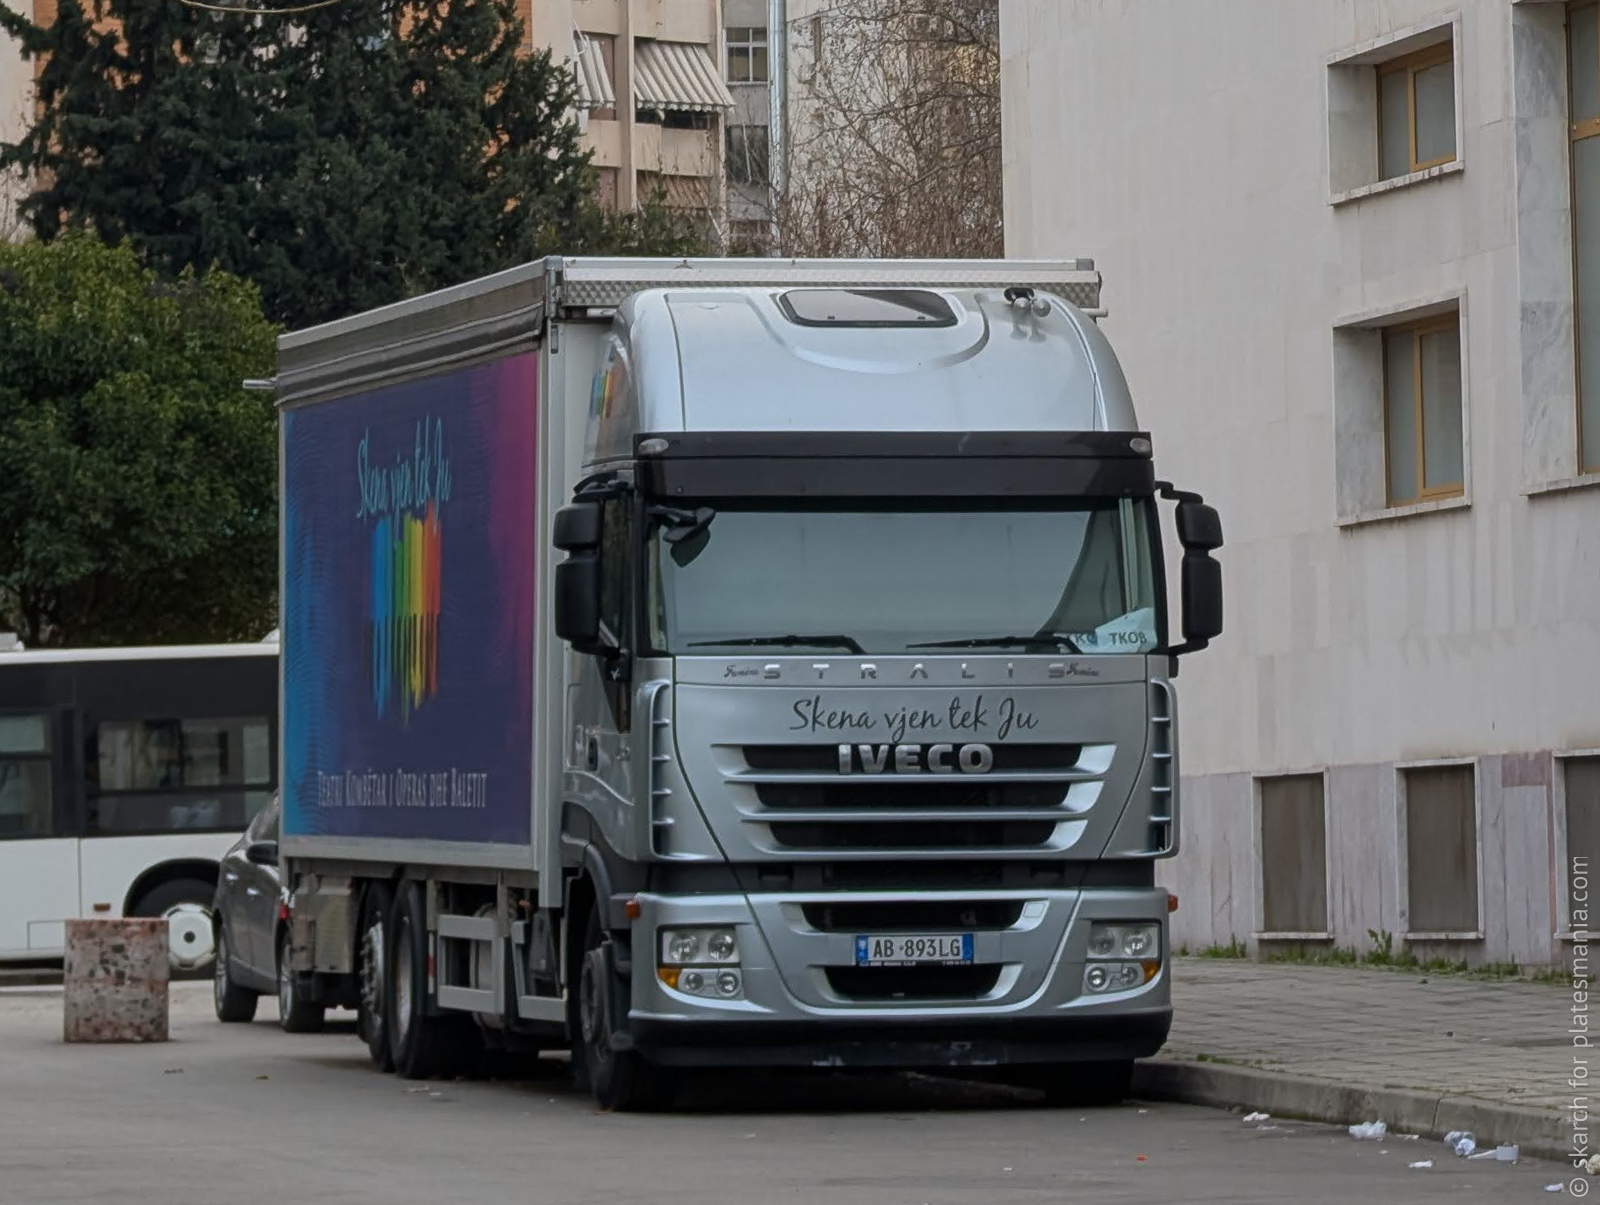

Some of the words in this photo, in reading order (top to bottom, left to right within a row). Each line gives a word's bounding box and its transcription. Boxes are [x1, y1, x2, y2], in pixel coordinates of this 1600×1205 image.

[356, 425, 388, 524] Skena
[414, 413, 431, 511] tek
[433, 416, 452, 535] Ju
[763, 662, 1066, 680] STRALIS
[789, 694, 877, 733] Skena
[883, 706, 943, 744] vjen
[947, 694, 989, 733] tek
[997, 697, 1040, 741] Ju
[838, 743, 994, 775] IVECO
[873, 939, 895, 958] AB
